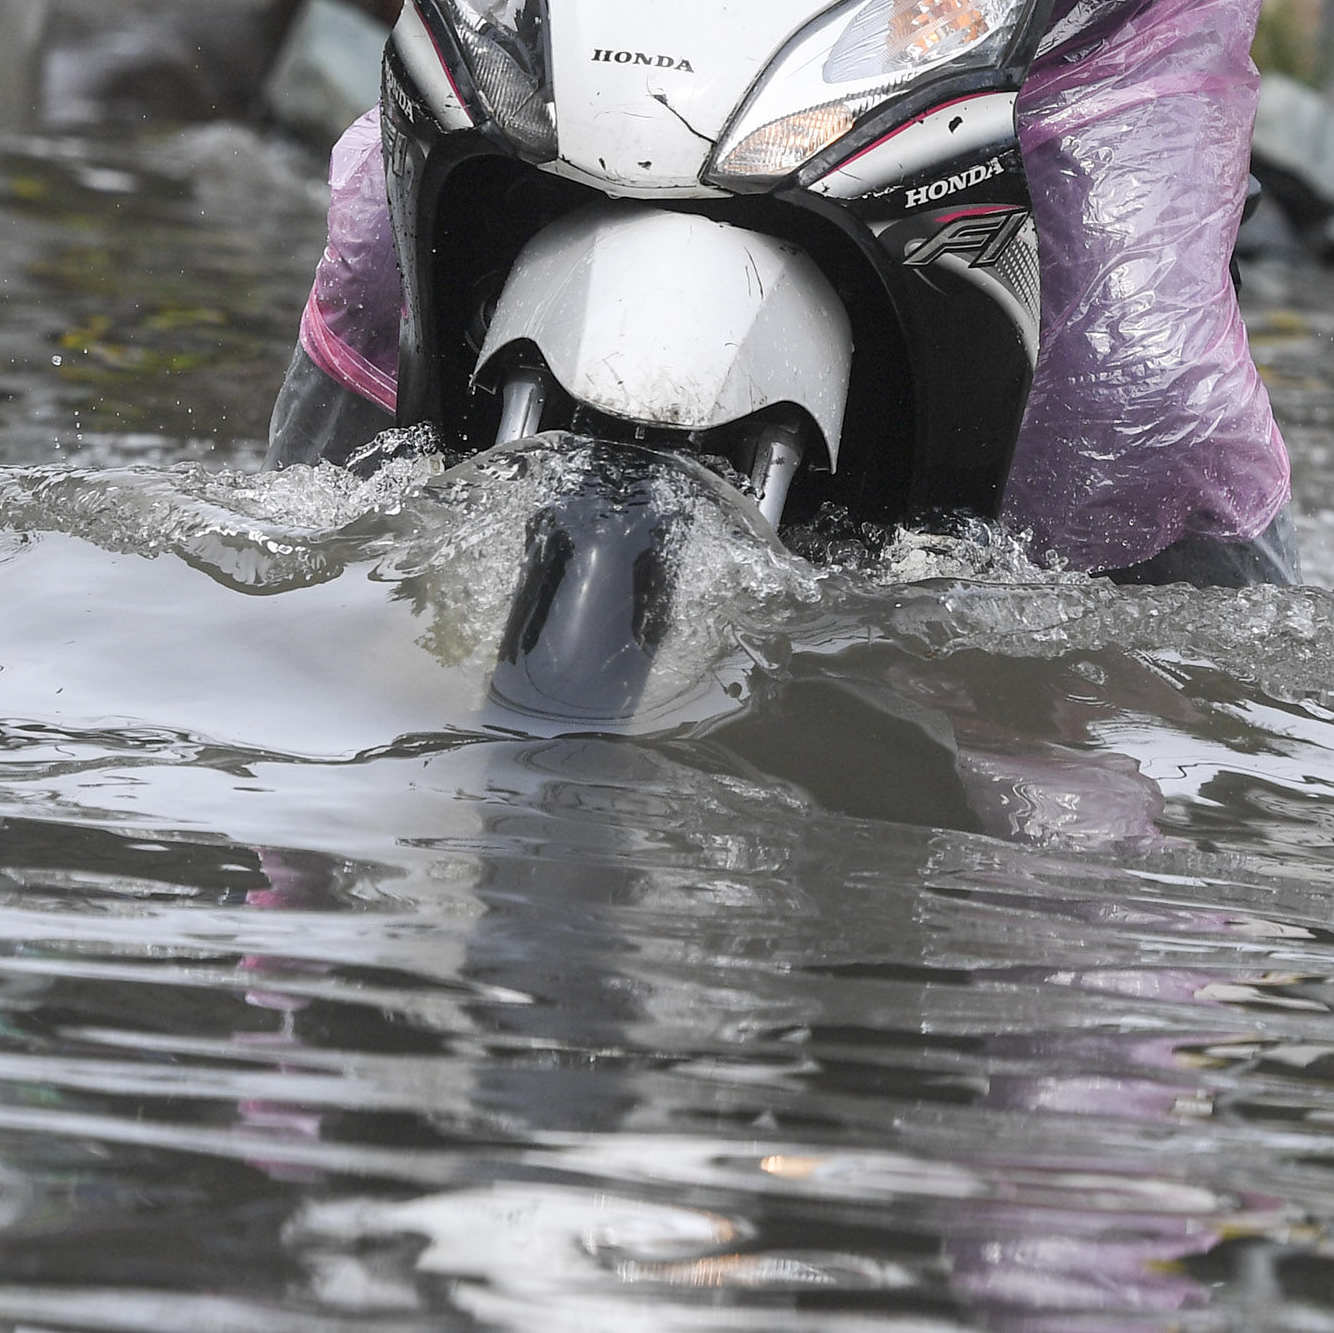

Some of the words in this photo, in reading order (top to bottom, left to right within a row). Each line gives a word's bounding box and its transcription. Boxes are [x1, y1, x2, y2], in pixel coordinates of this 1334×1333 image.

[590, 48, 696, 74] HONDA
[903, 156, 1006, 209] HONDA
[902, 209, 1030, 269] FI
